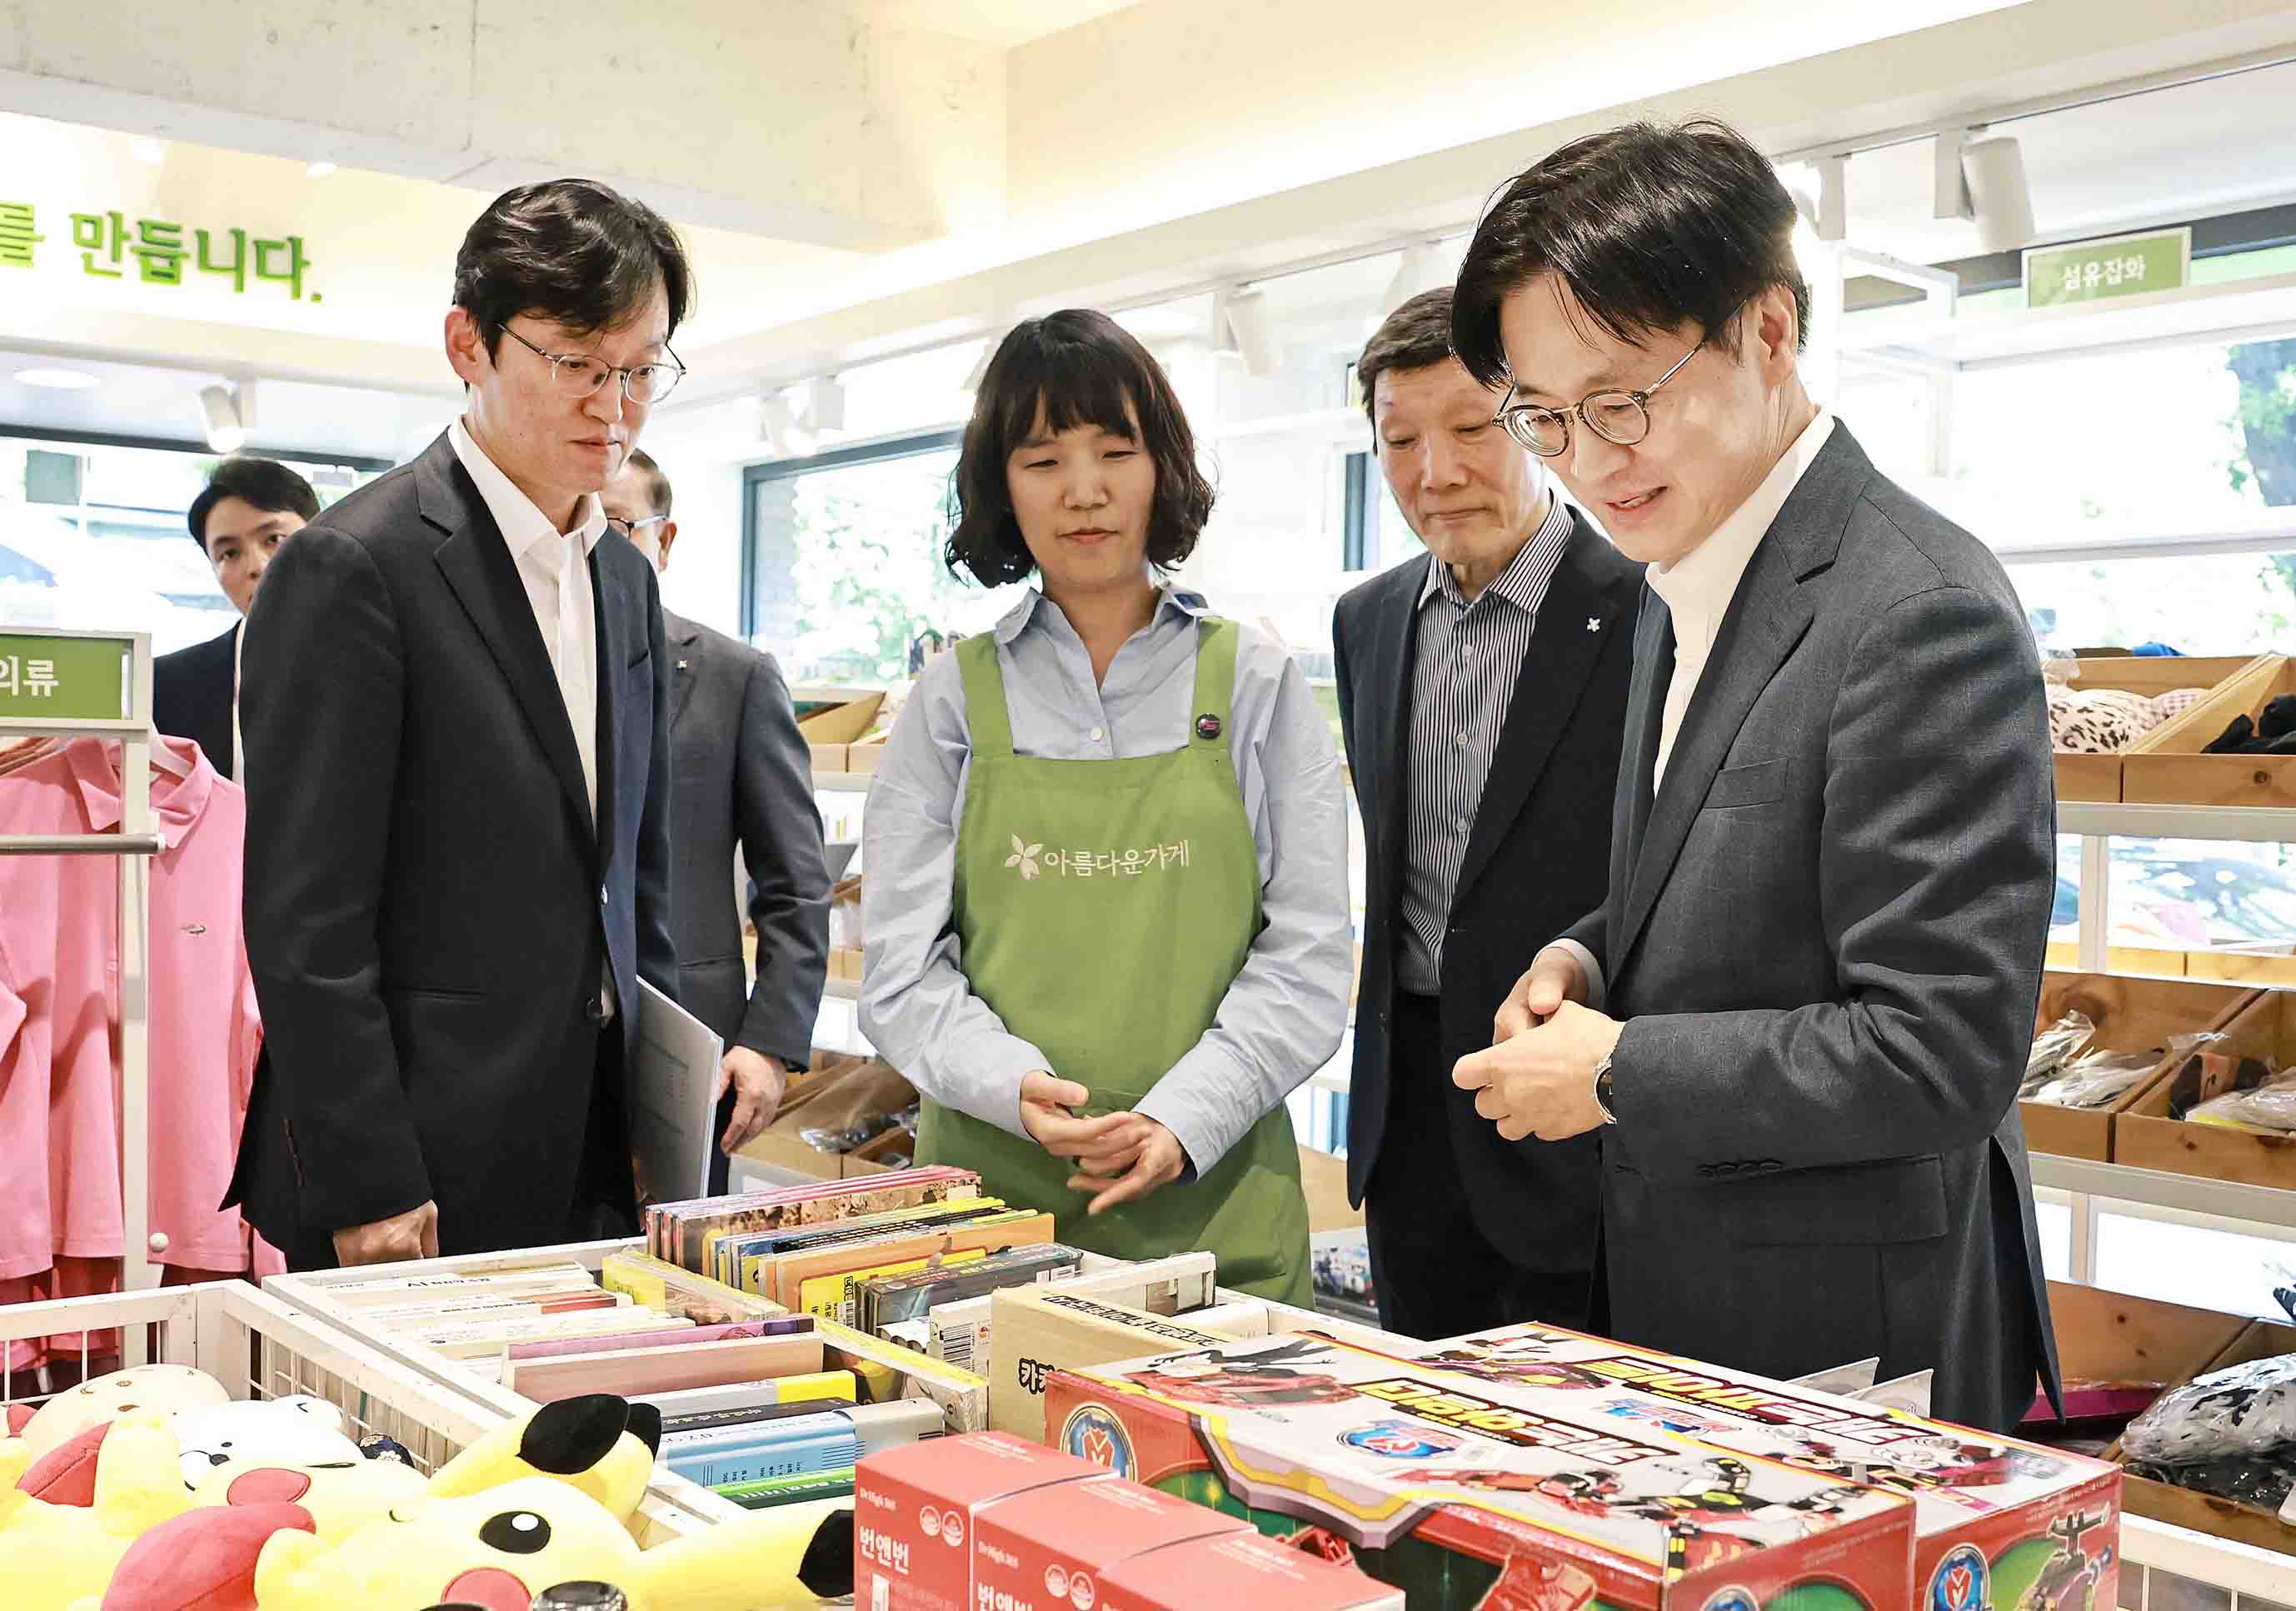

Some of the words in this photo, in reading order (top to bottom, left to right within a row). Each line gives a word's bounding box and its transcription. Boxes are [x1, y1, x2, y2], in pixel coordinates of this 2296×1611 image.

[0, 200, 45, 268] 를
[69, 211, 322, 302] 만듭니다.
[2063, 253, 2146, 291] 섬유잡화
[0, 655, 59, 698] 의류
[1044, 839, 1190, 877] 아름다운가게
[859, 1525, 910, 1574] 번앤번
